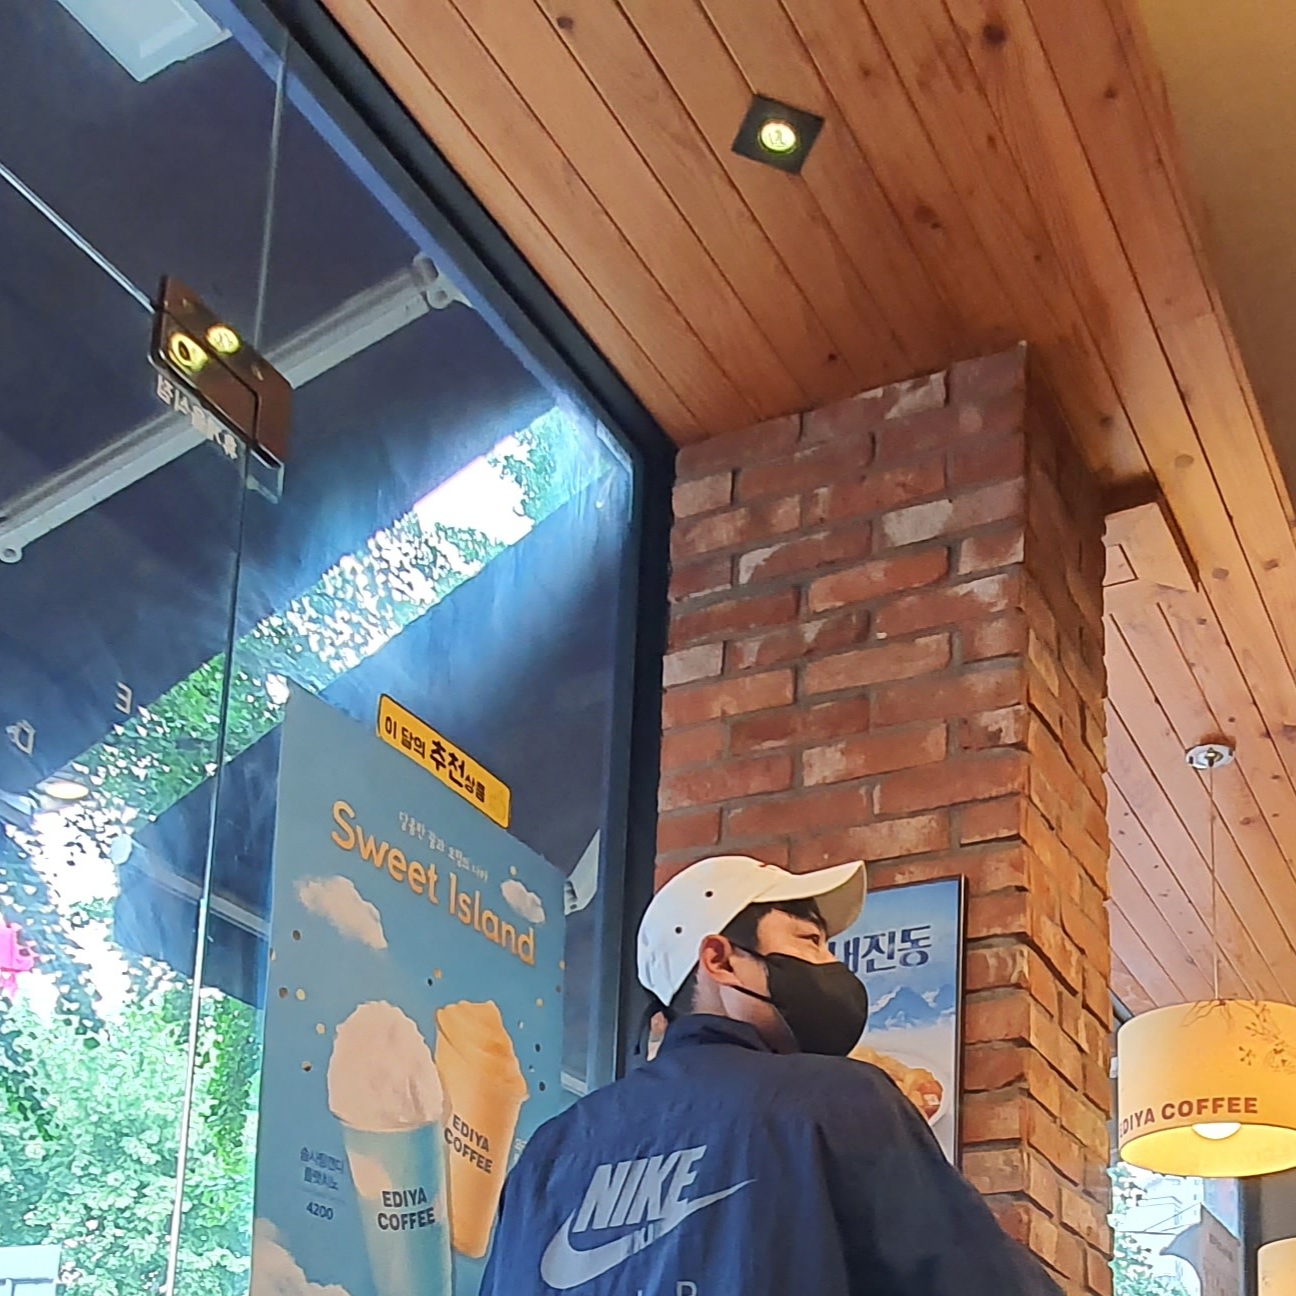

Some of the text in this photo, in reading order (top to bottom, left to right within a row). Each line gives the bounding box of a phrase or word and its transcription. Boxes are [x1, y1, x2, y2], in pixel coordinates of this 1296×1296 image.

[385, 716, 397, 739] 이
[331, 800, 536, 966] Sweet Island
[1161, 1097, 1258, 1120] COFFEE
[452, 1114, 490, 1153] EDIYA
[444, 1127, 493, 1174] COFFEE
[382, 1187, 427, 1208] EDIYA
[572, 1145, 707, 1233] NIKE
[306, 1201, 334, 1221] 4200
[377, 1207, 435, 1230] COFFEE
